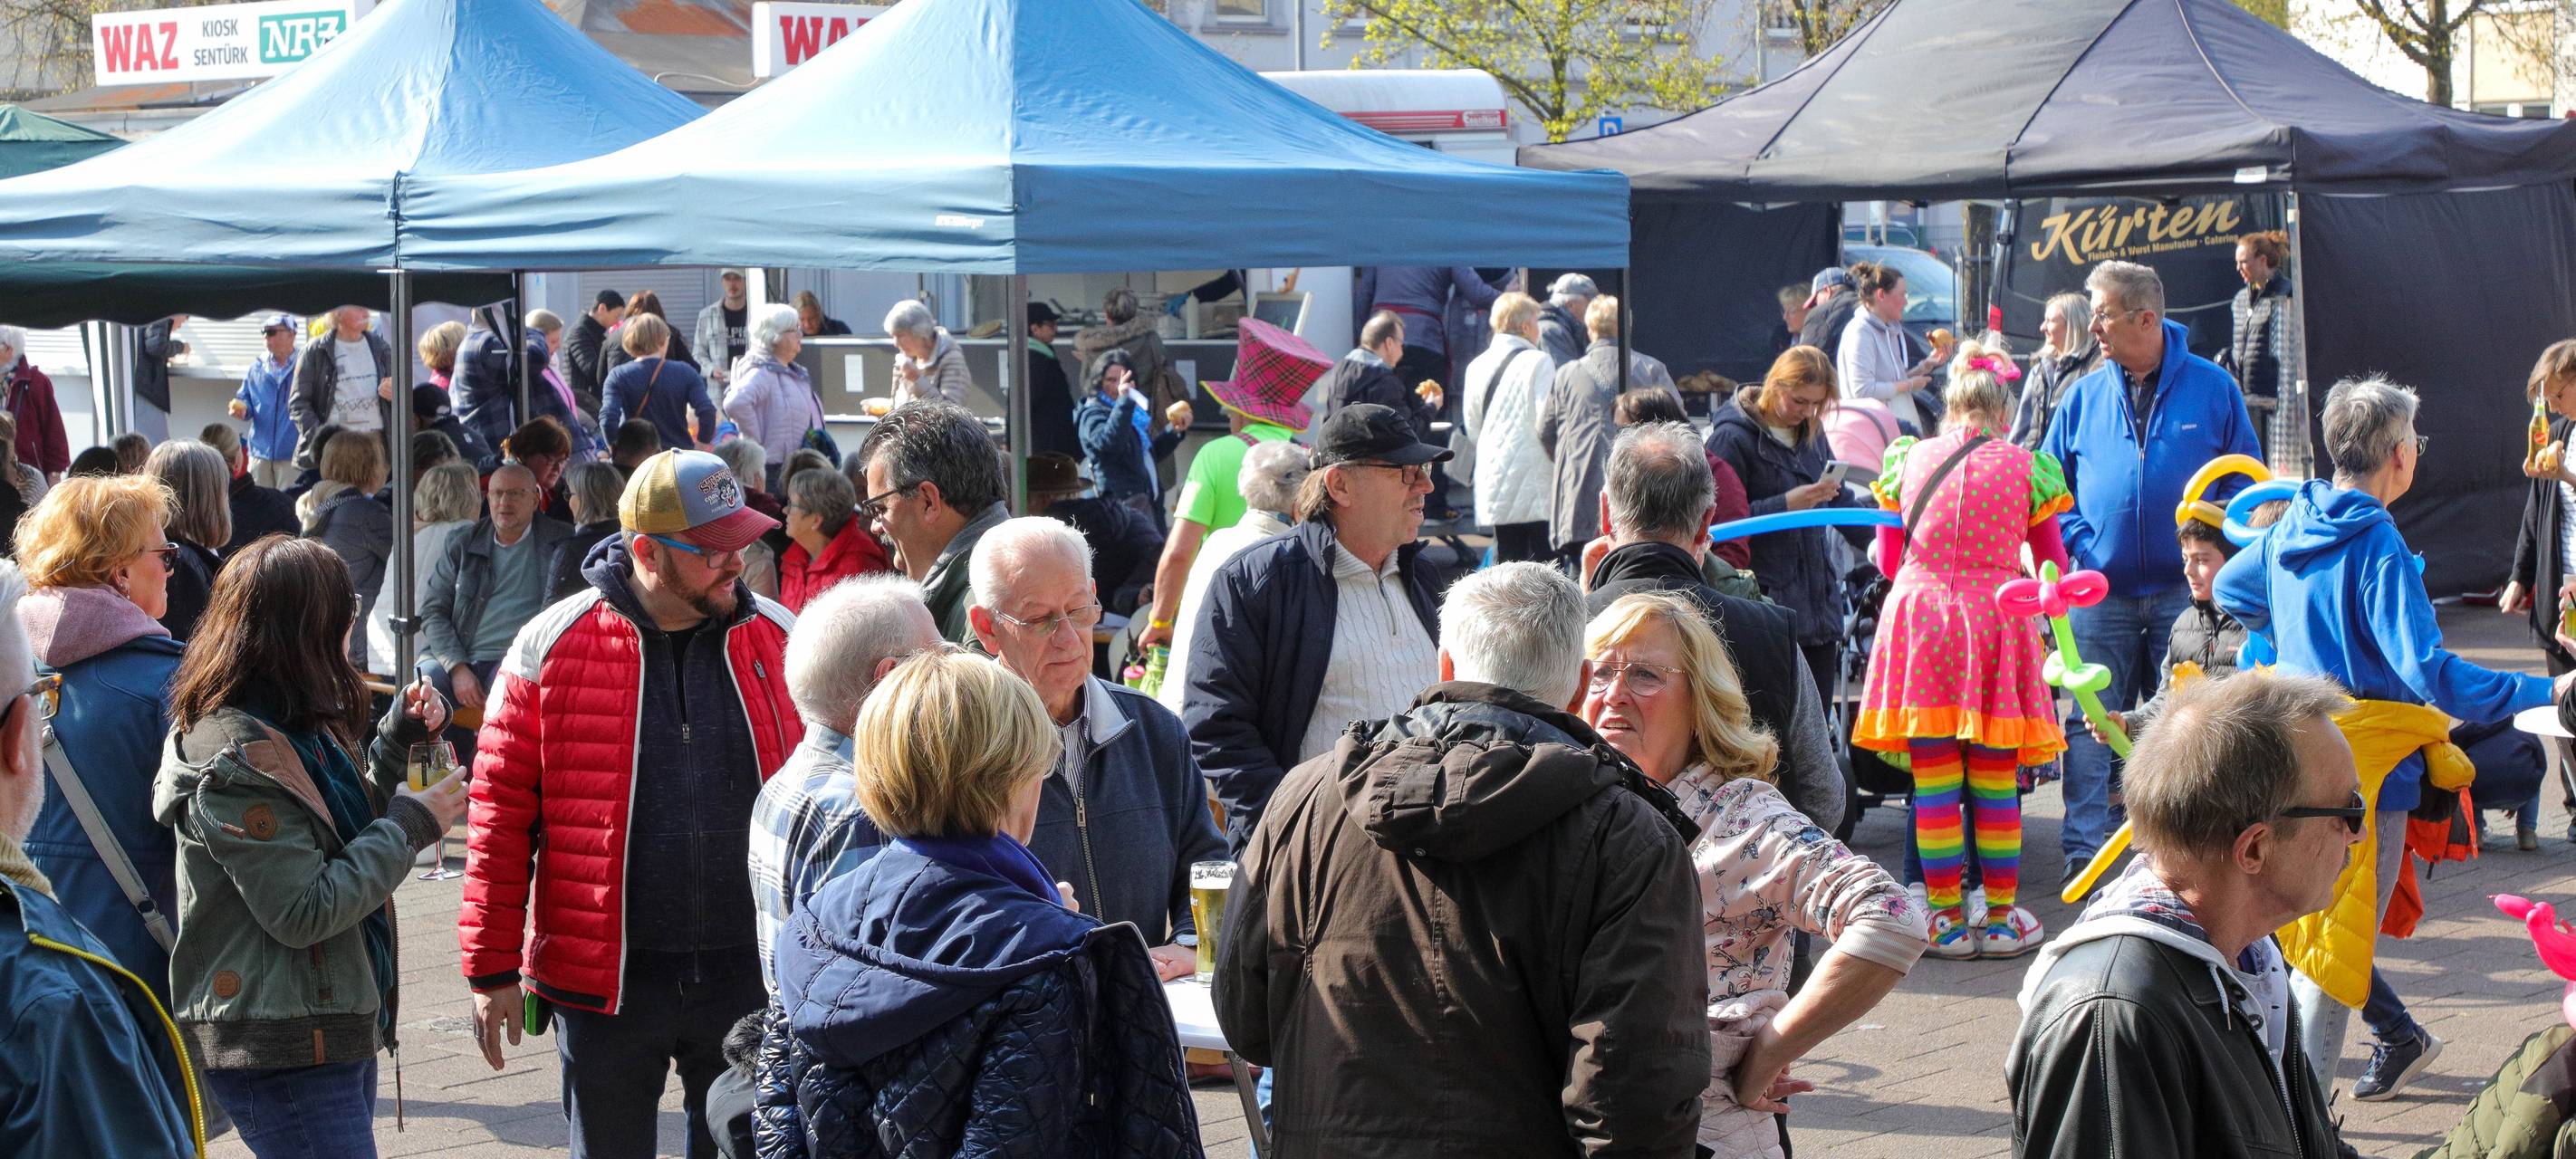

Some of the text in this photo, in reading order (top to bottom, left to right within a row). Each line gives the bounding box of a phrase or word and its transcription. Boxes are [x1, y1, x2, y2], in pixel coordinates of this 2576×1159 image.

[101, 21, 178, 72] WAZ
[202, 18, 238, 38] KIOSK
[780, 15, 872, 65] WA
[194, 43, 248, 66] SENTÜRK
[2031, 200, 2240, 265] Kürten
[2119, 247, 2126, 257] &
[2129, 244, 2150, 256] Wurst
[2152, 238, 2197, 253] Manufactur
[2204, 233, 2239, 245] Catering
